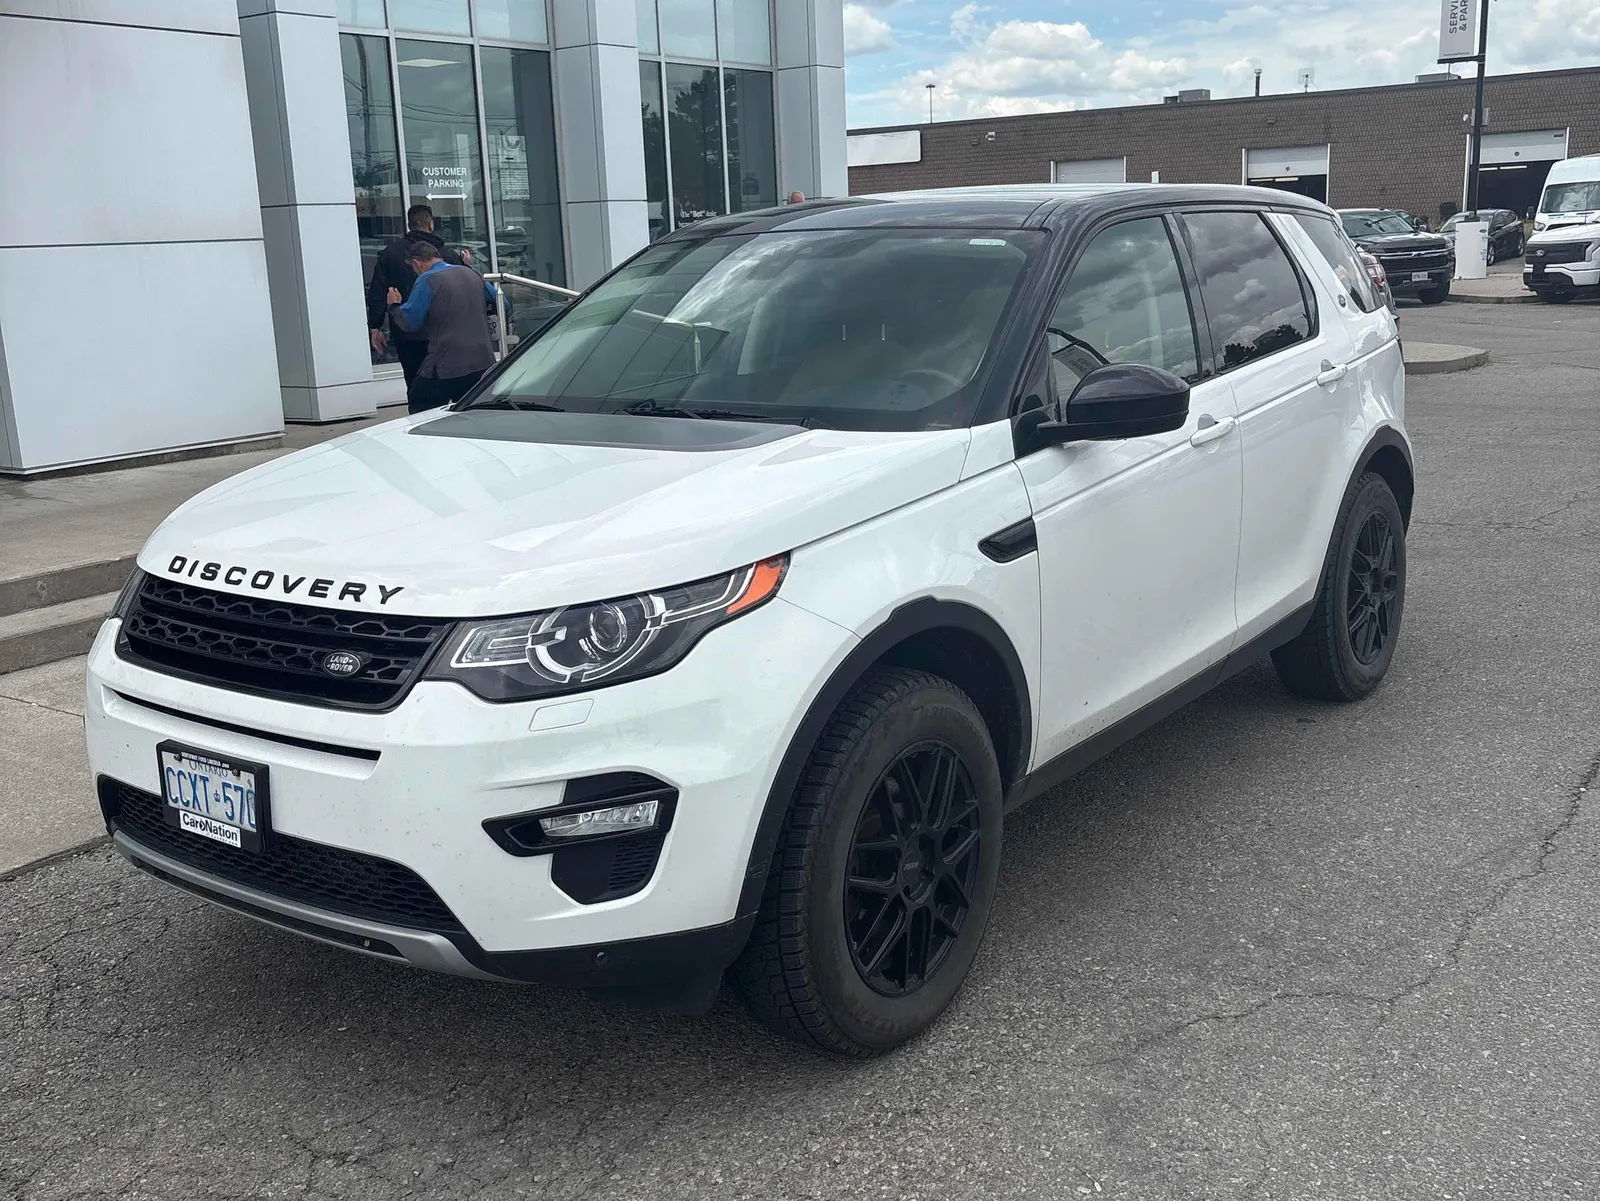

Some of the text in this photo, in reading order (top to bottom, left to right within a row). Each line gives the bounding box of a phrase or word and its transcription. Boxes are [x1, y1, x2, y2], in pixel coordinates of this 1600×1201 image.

[422, 166, 467, 176] CUSTOMER
[428, 179, 464, 188] PARKING
[168, 555, 405, 605] DISCOVERY
[166, 766, 210, 814] CCXT
